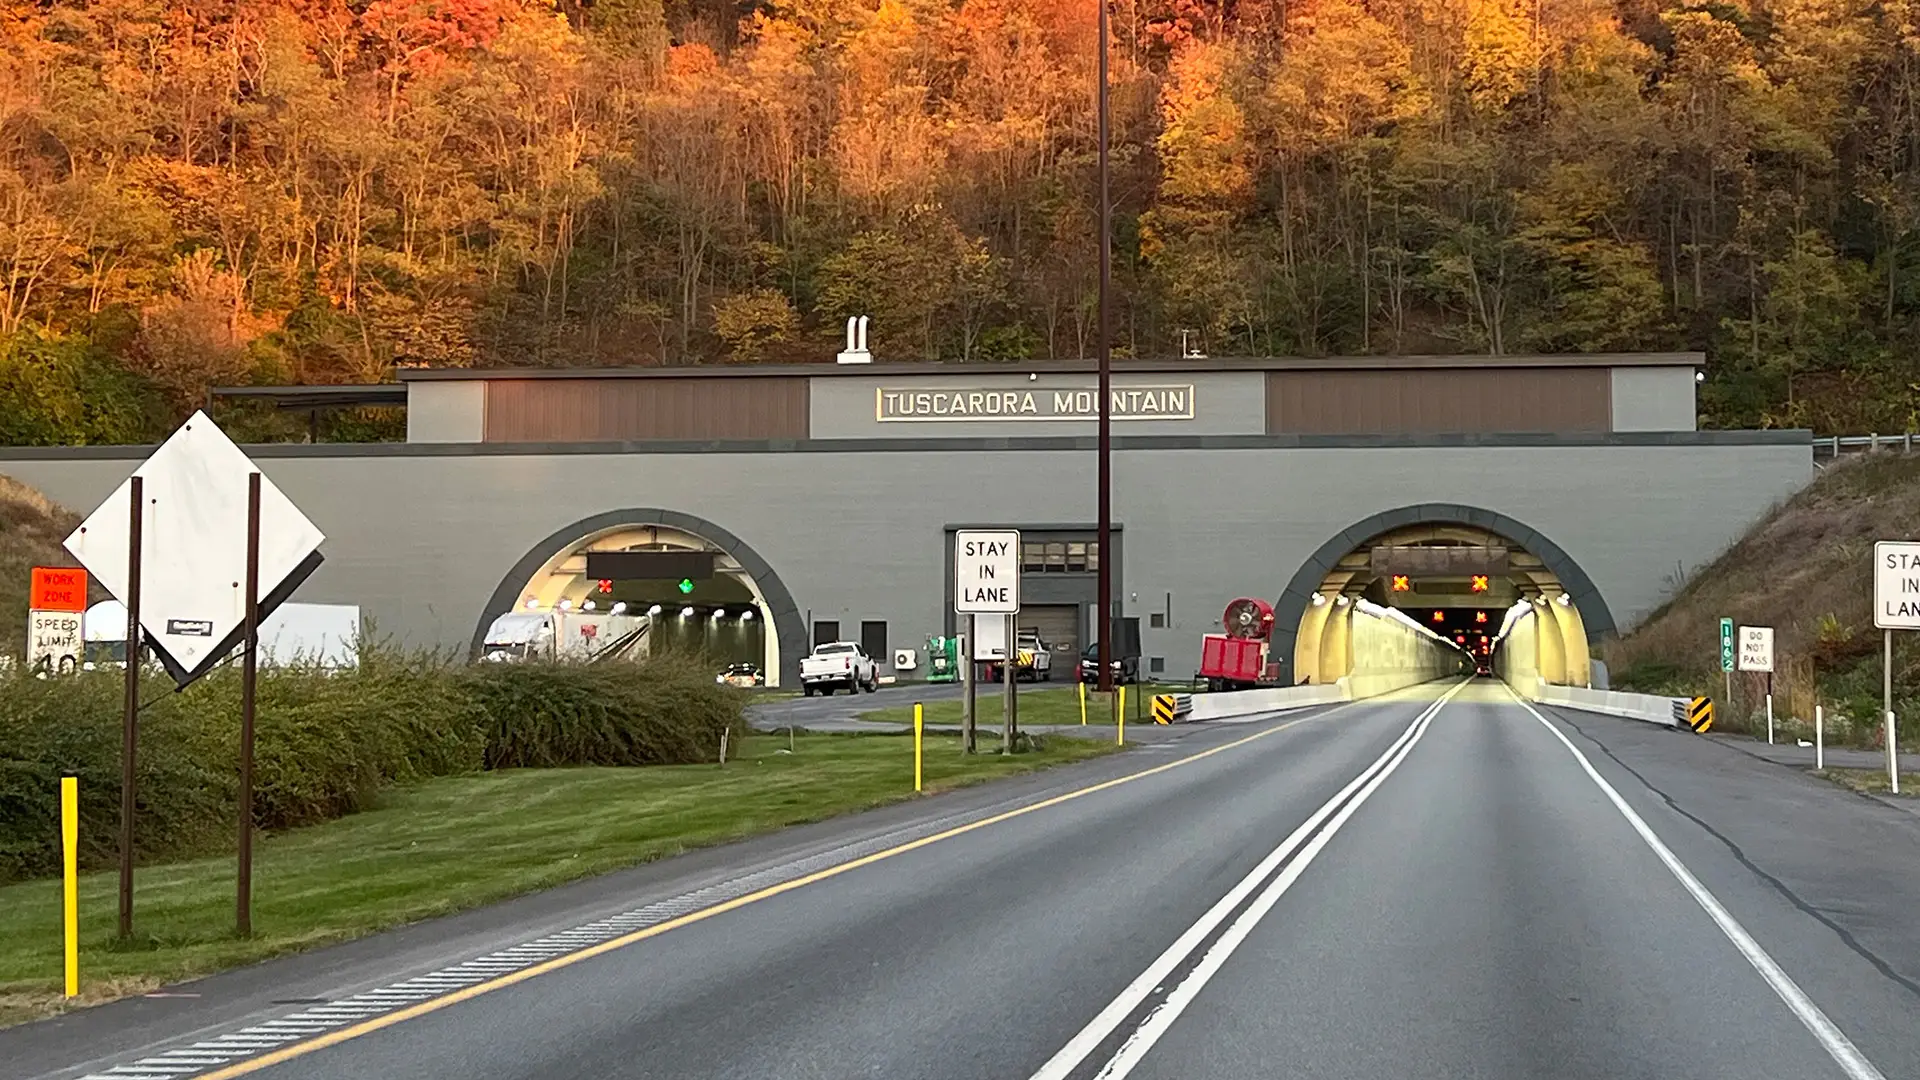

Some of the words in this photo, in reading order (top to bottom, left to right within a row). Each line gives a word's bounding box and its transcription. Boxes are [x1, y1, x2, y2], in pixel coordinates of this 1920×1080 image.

[884, 392, 1037, 414] TUSCARORA
[965, 541, 1008, 556] STAY
[979, 564, 994, 579] IN
[43, 573, 75, 586] WORK
[1902, 577, 1919, 593] IN
[43, 590, 73, 603] ZONE
[964, 587, 1008, 602] LANE
[36, 619, 78, 631] SPEED
[38, 635, 72, 647] LIMIT
[1749, 631, 1763, 640] DO
[1723, 625, 1733, 670] 1862
[1746, 643, 1764, 652] NOT
[1743, 655, 1768, 665] PASS
